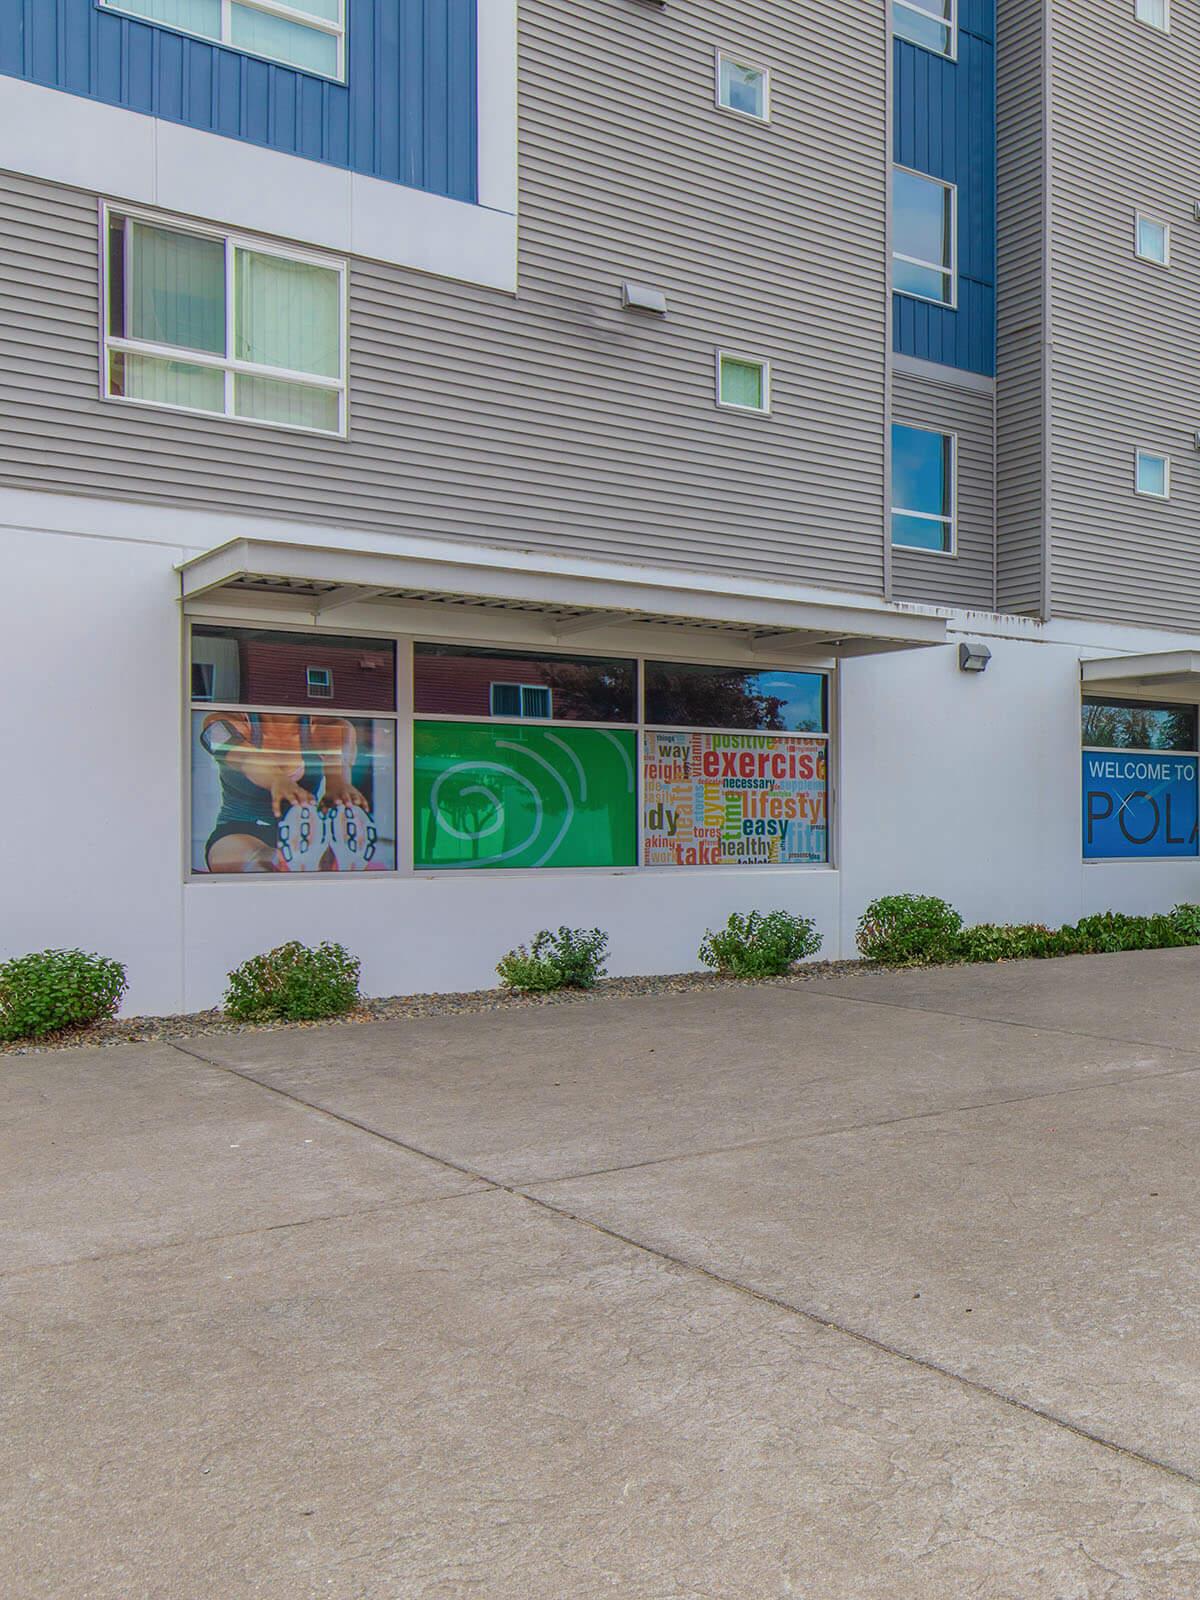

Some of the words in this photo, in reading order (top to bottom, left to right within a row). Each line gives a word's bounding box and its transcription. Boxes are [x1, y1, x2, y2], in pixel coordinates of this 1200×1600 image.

[658, 744, 691, 765] way
[1089, 761, 1170, 780] WELCOME
[1174, 763, 1195, 782] TO
[723, 777, 775, 792] necessary
[703, 783, 725, 827] gym
[719, 791, 742, 841] time
[644, 801, 681, 837] dy
[742, 818, 790, 845] easy
[676, 841, 721, 865] take
